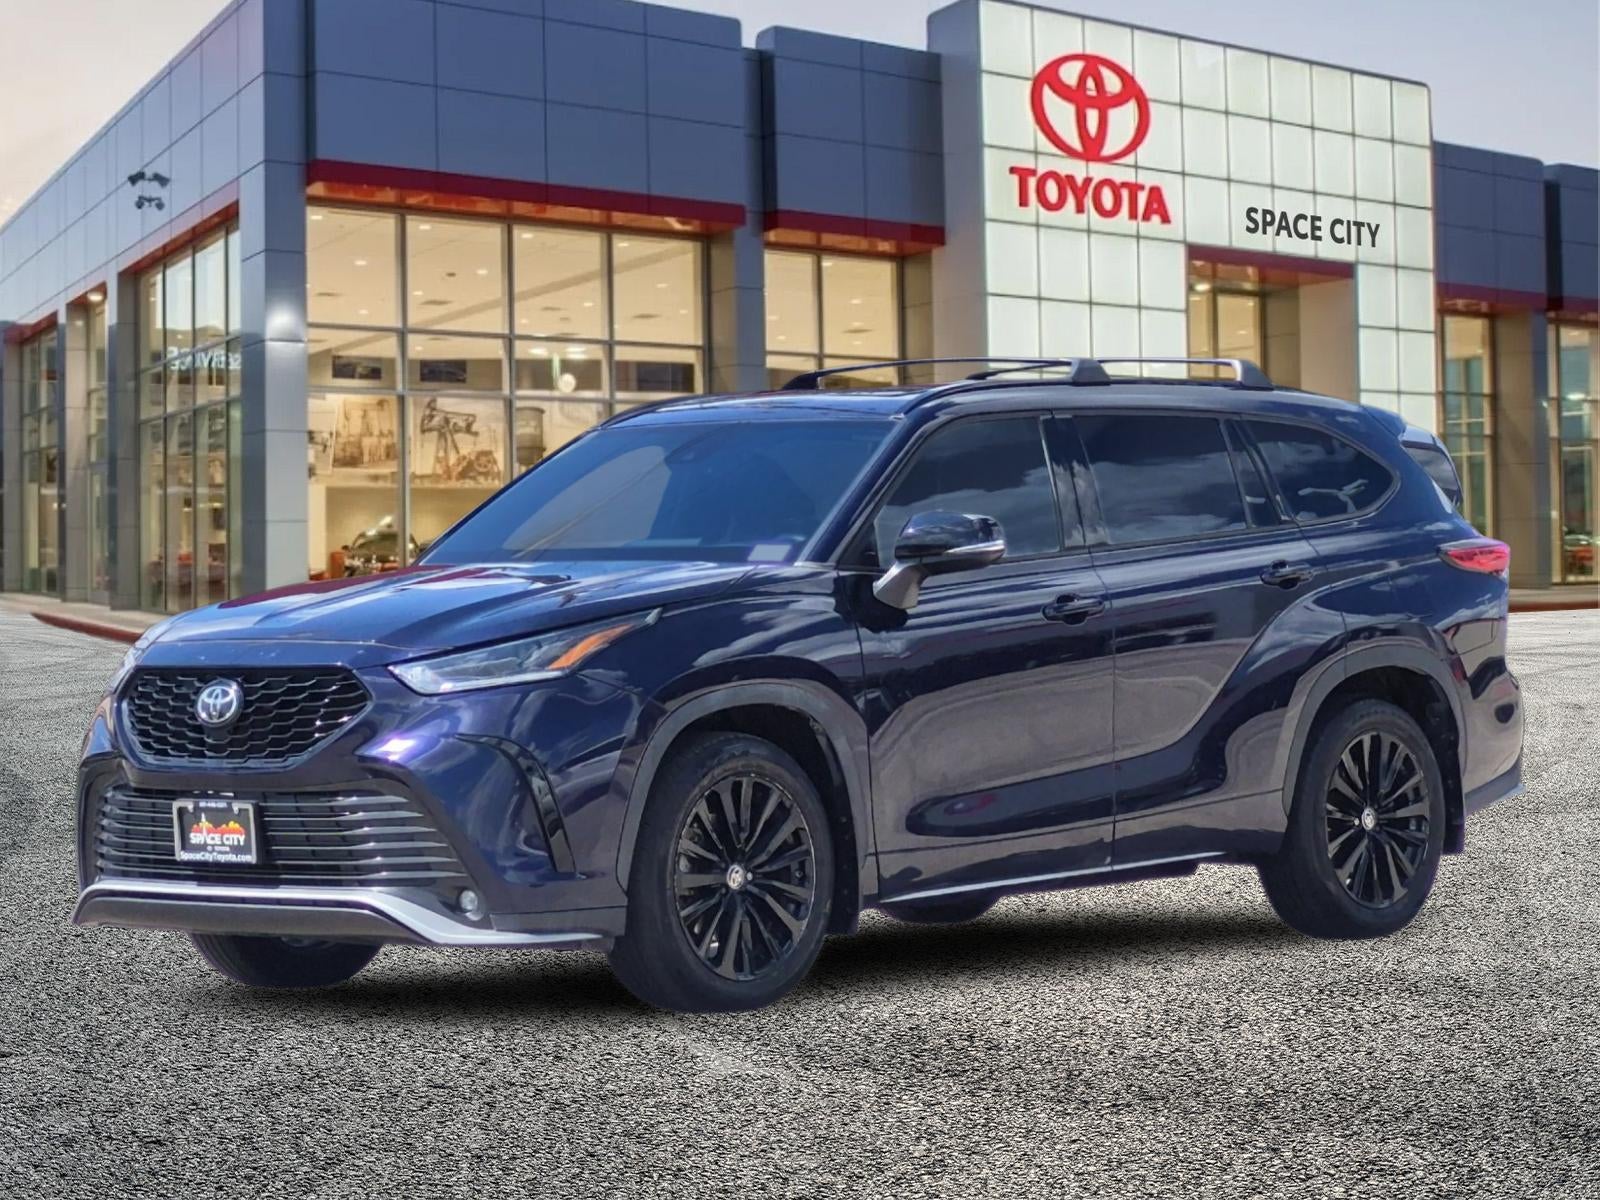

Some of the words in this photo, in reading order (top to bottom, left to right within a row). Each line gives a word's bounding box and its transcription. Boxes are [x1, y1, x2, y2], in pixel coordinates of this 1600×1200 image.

[1009, 166, 1171, 224] TOYOTA
[1245, 206, 1323, 242] SPACE
[1329, 217, 1381, 248] CITY
[189, 832, 222, 845] SPACE
[222, 834, 246, 846] CITY
[180, 850, 253, 863] SpaceCityToyota.com
